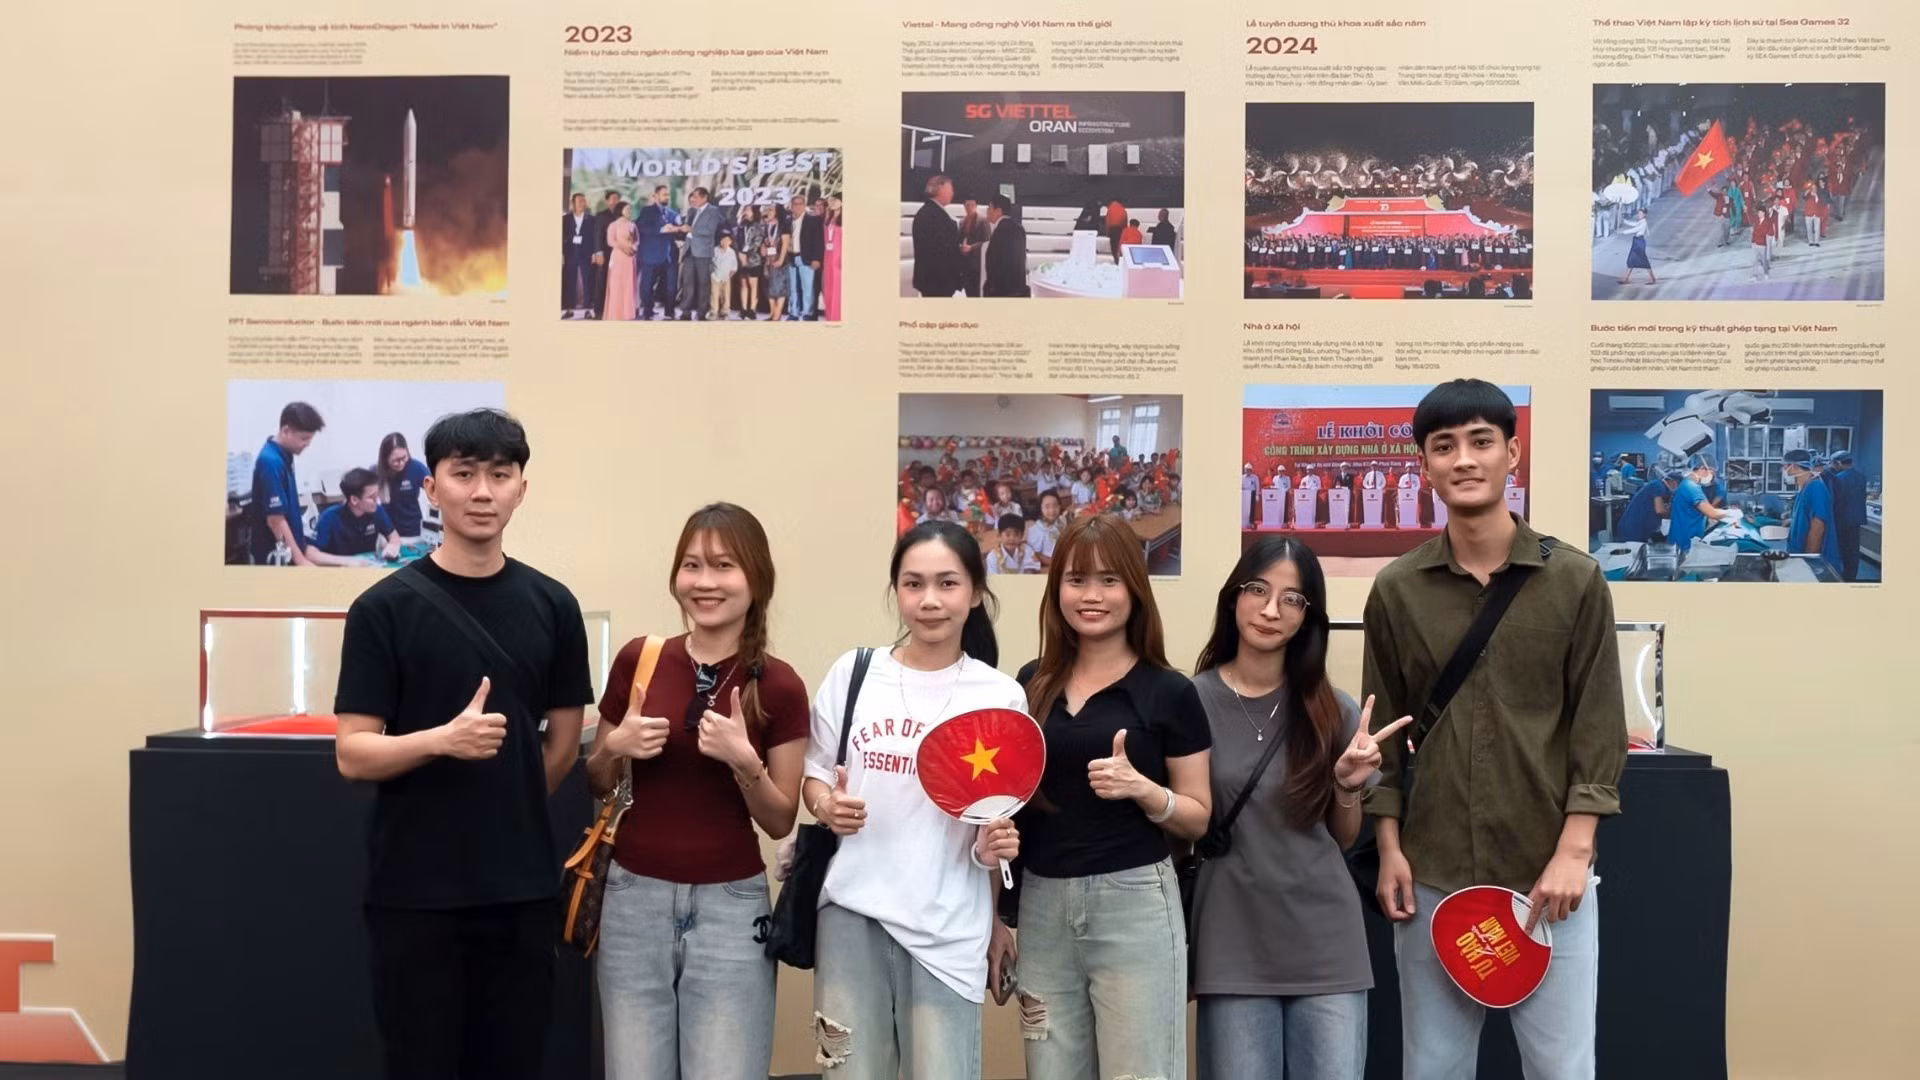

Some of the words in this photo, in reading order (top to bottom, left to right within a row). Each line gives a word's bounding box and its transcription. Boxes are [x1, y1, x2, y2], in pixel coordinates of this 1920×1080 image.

[564, 25, 632, 43] 2023
[1246, 37, 1318, 54] 2024
[995, 104, 1076, 118] VIETTEL
[1029, 120, 1077, 132] ORAN
[613, 155, 748, 177] WORLD'S
[757, 152, 833, 173] BEST
[719, 187, 791, 206] 2023
[1317, 421, 1336, 440] LỄ
[1339, 422, 1384, 438] KHỞI
[852, 718, 894, 752] FEAR
[902, 718, 926, 739] OF
